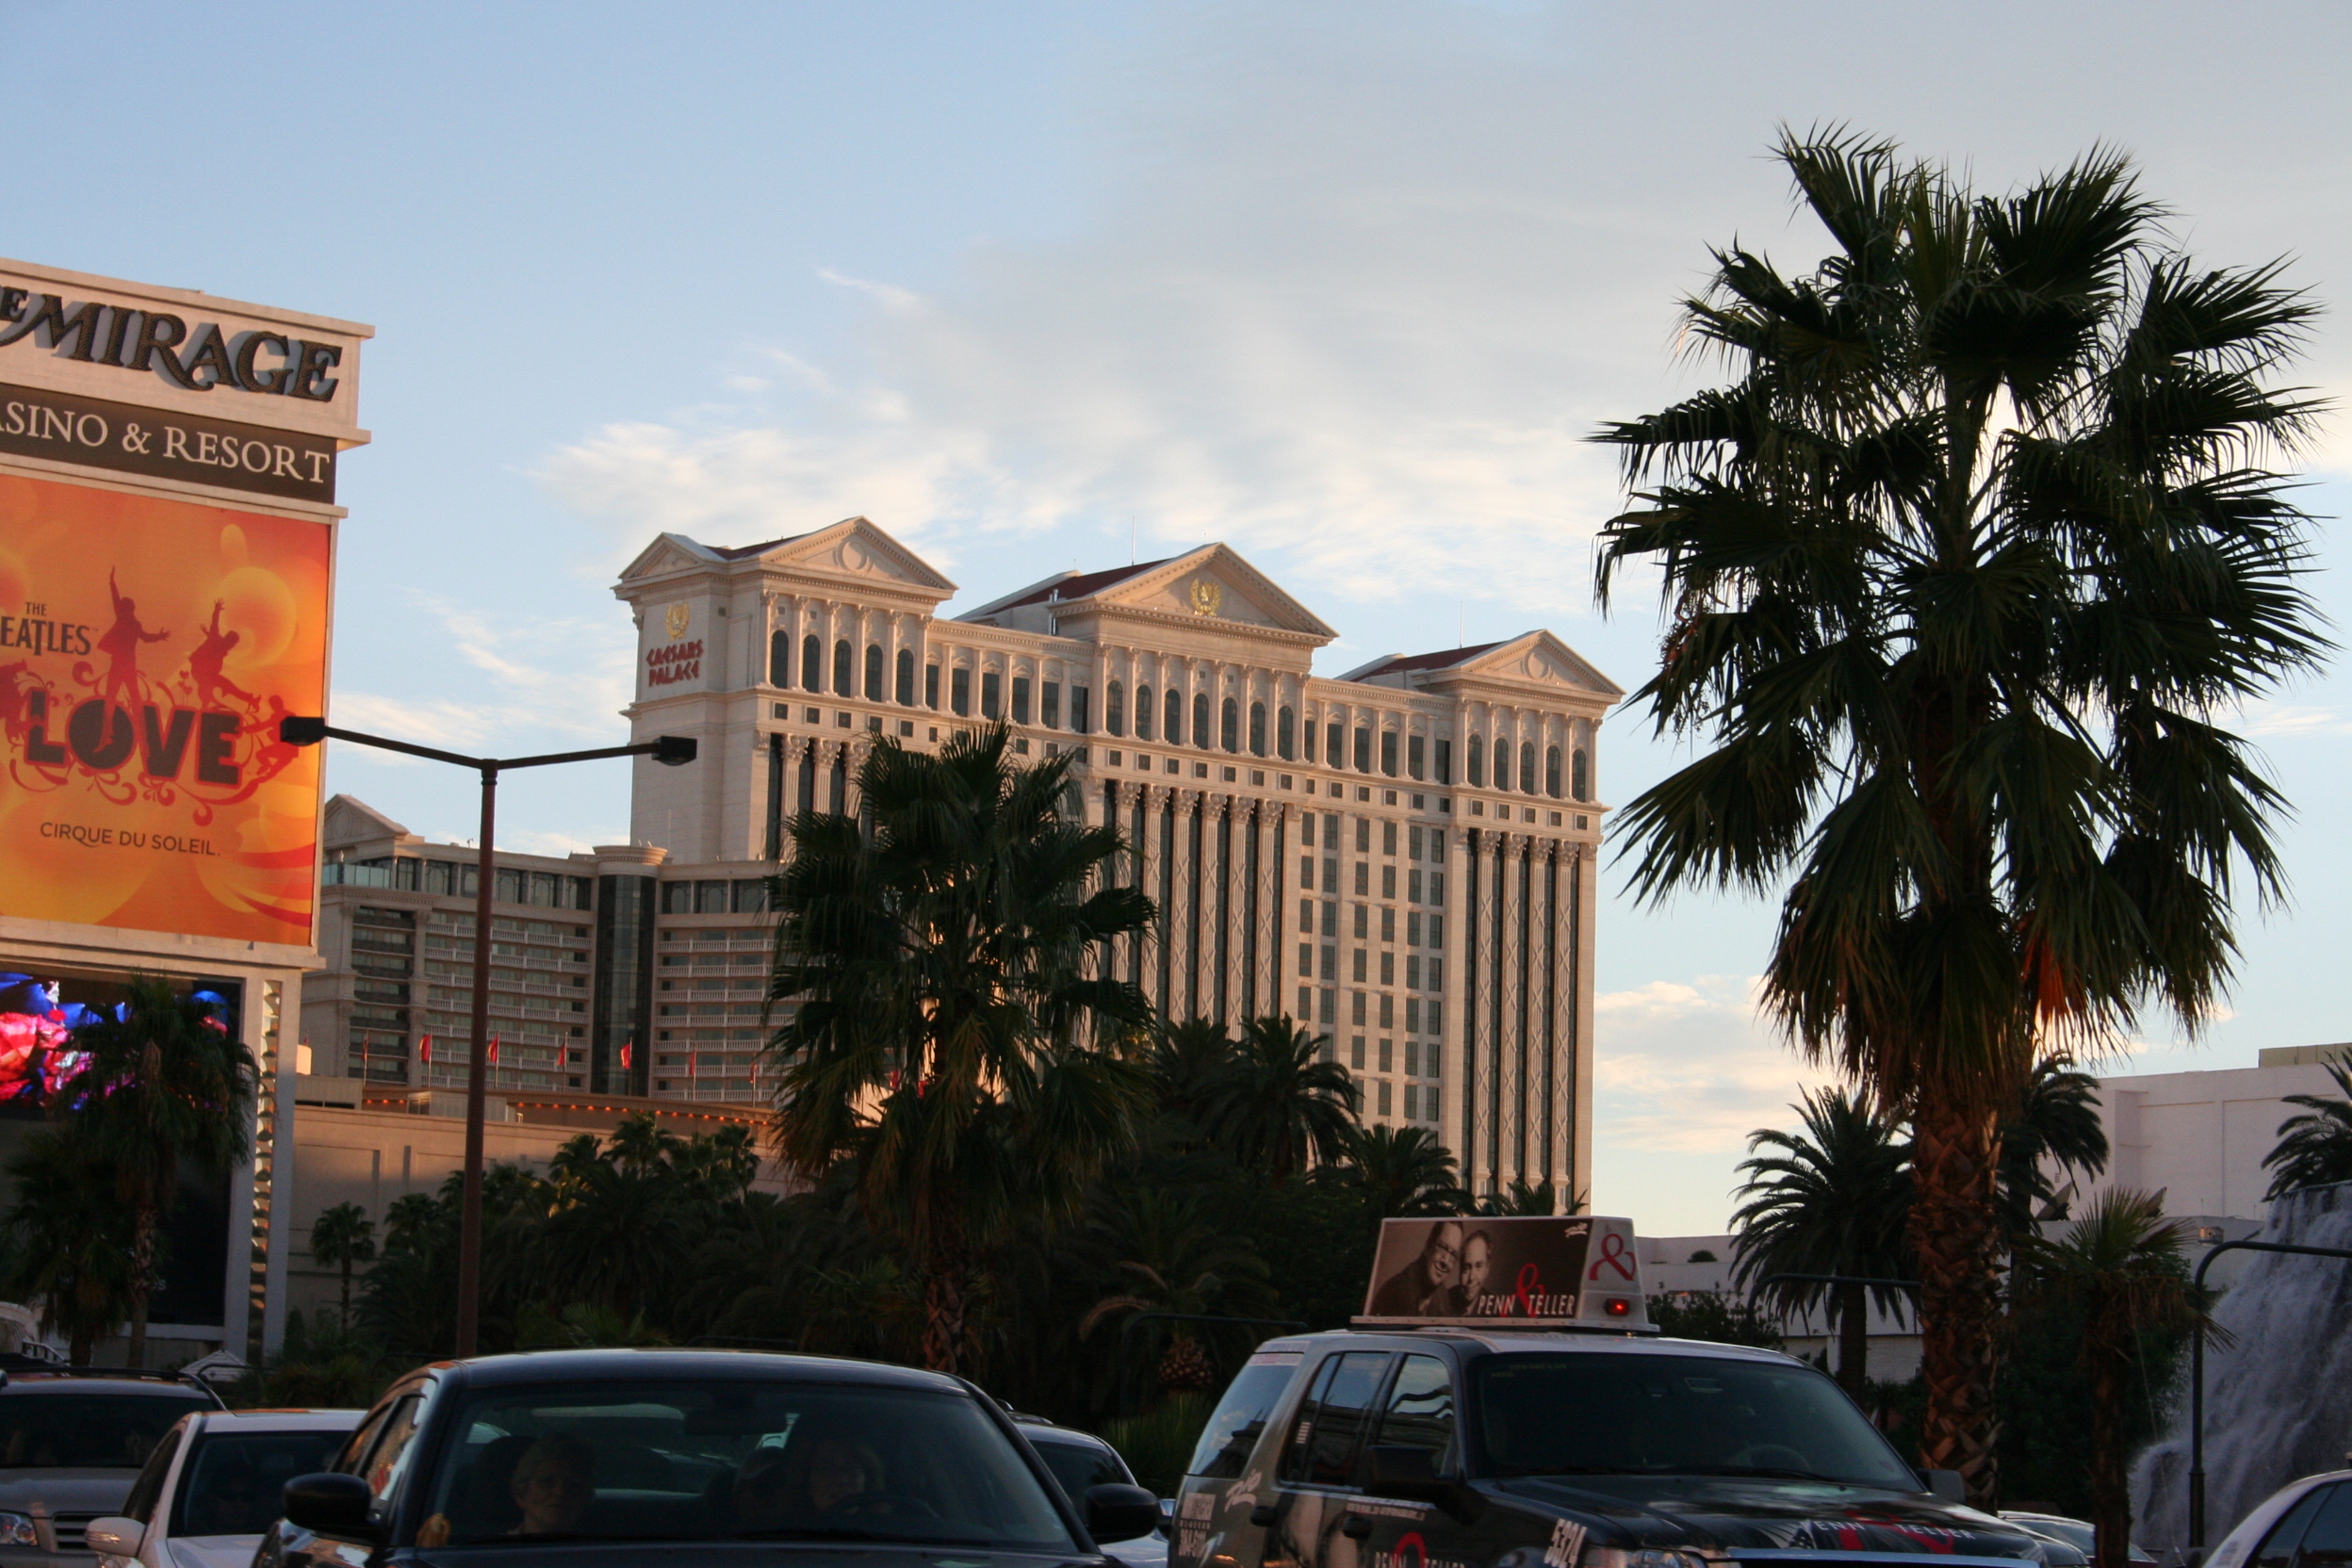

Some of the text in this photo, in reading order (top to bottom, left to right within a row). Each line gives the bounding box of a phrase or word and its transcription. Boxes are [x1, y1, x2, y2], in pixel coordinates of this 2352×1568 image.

[0, 293, 343, 402] MIRAGE
[0, 400, 330, 484] SINO & RESORT
[25, 601, 47, 617] THE
[646, 639, 704, 667] CAESARS
[648, 660, 700, 687] PALACE
[26, 688, 241, 787] LOVE
[41, 822, 216, 856] CIRQUE DU SOLEIL
[1589, 1233, 1637, 1282] &
[1477, 1294, 1515, 1315] PENN
[1527, 1294, 1575, 1315] TELLER
[1896, 1523, 1976, 1540] TELLER
